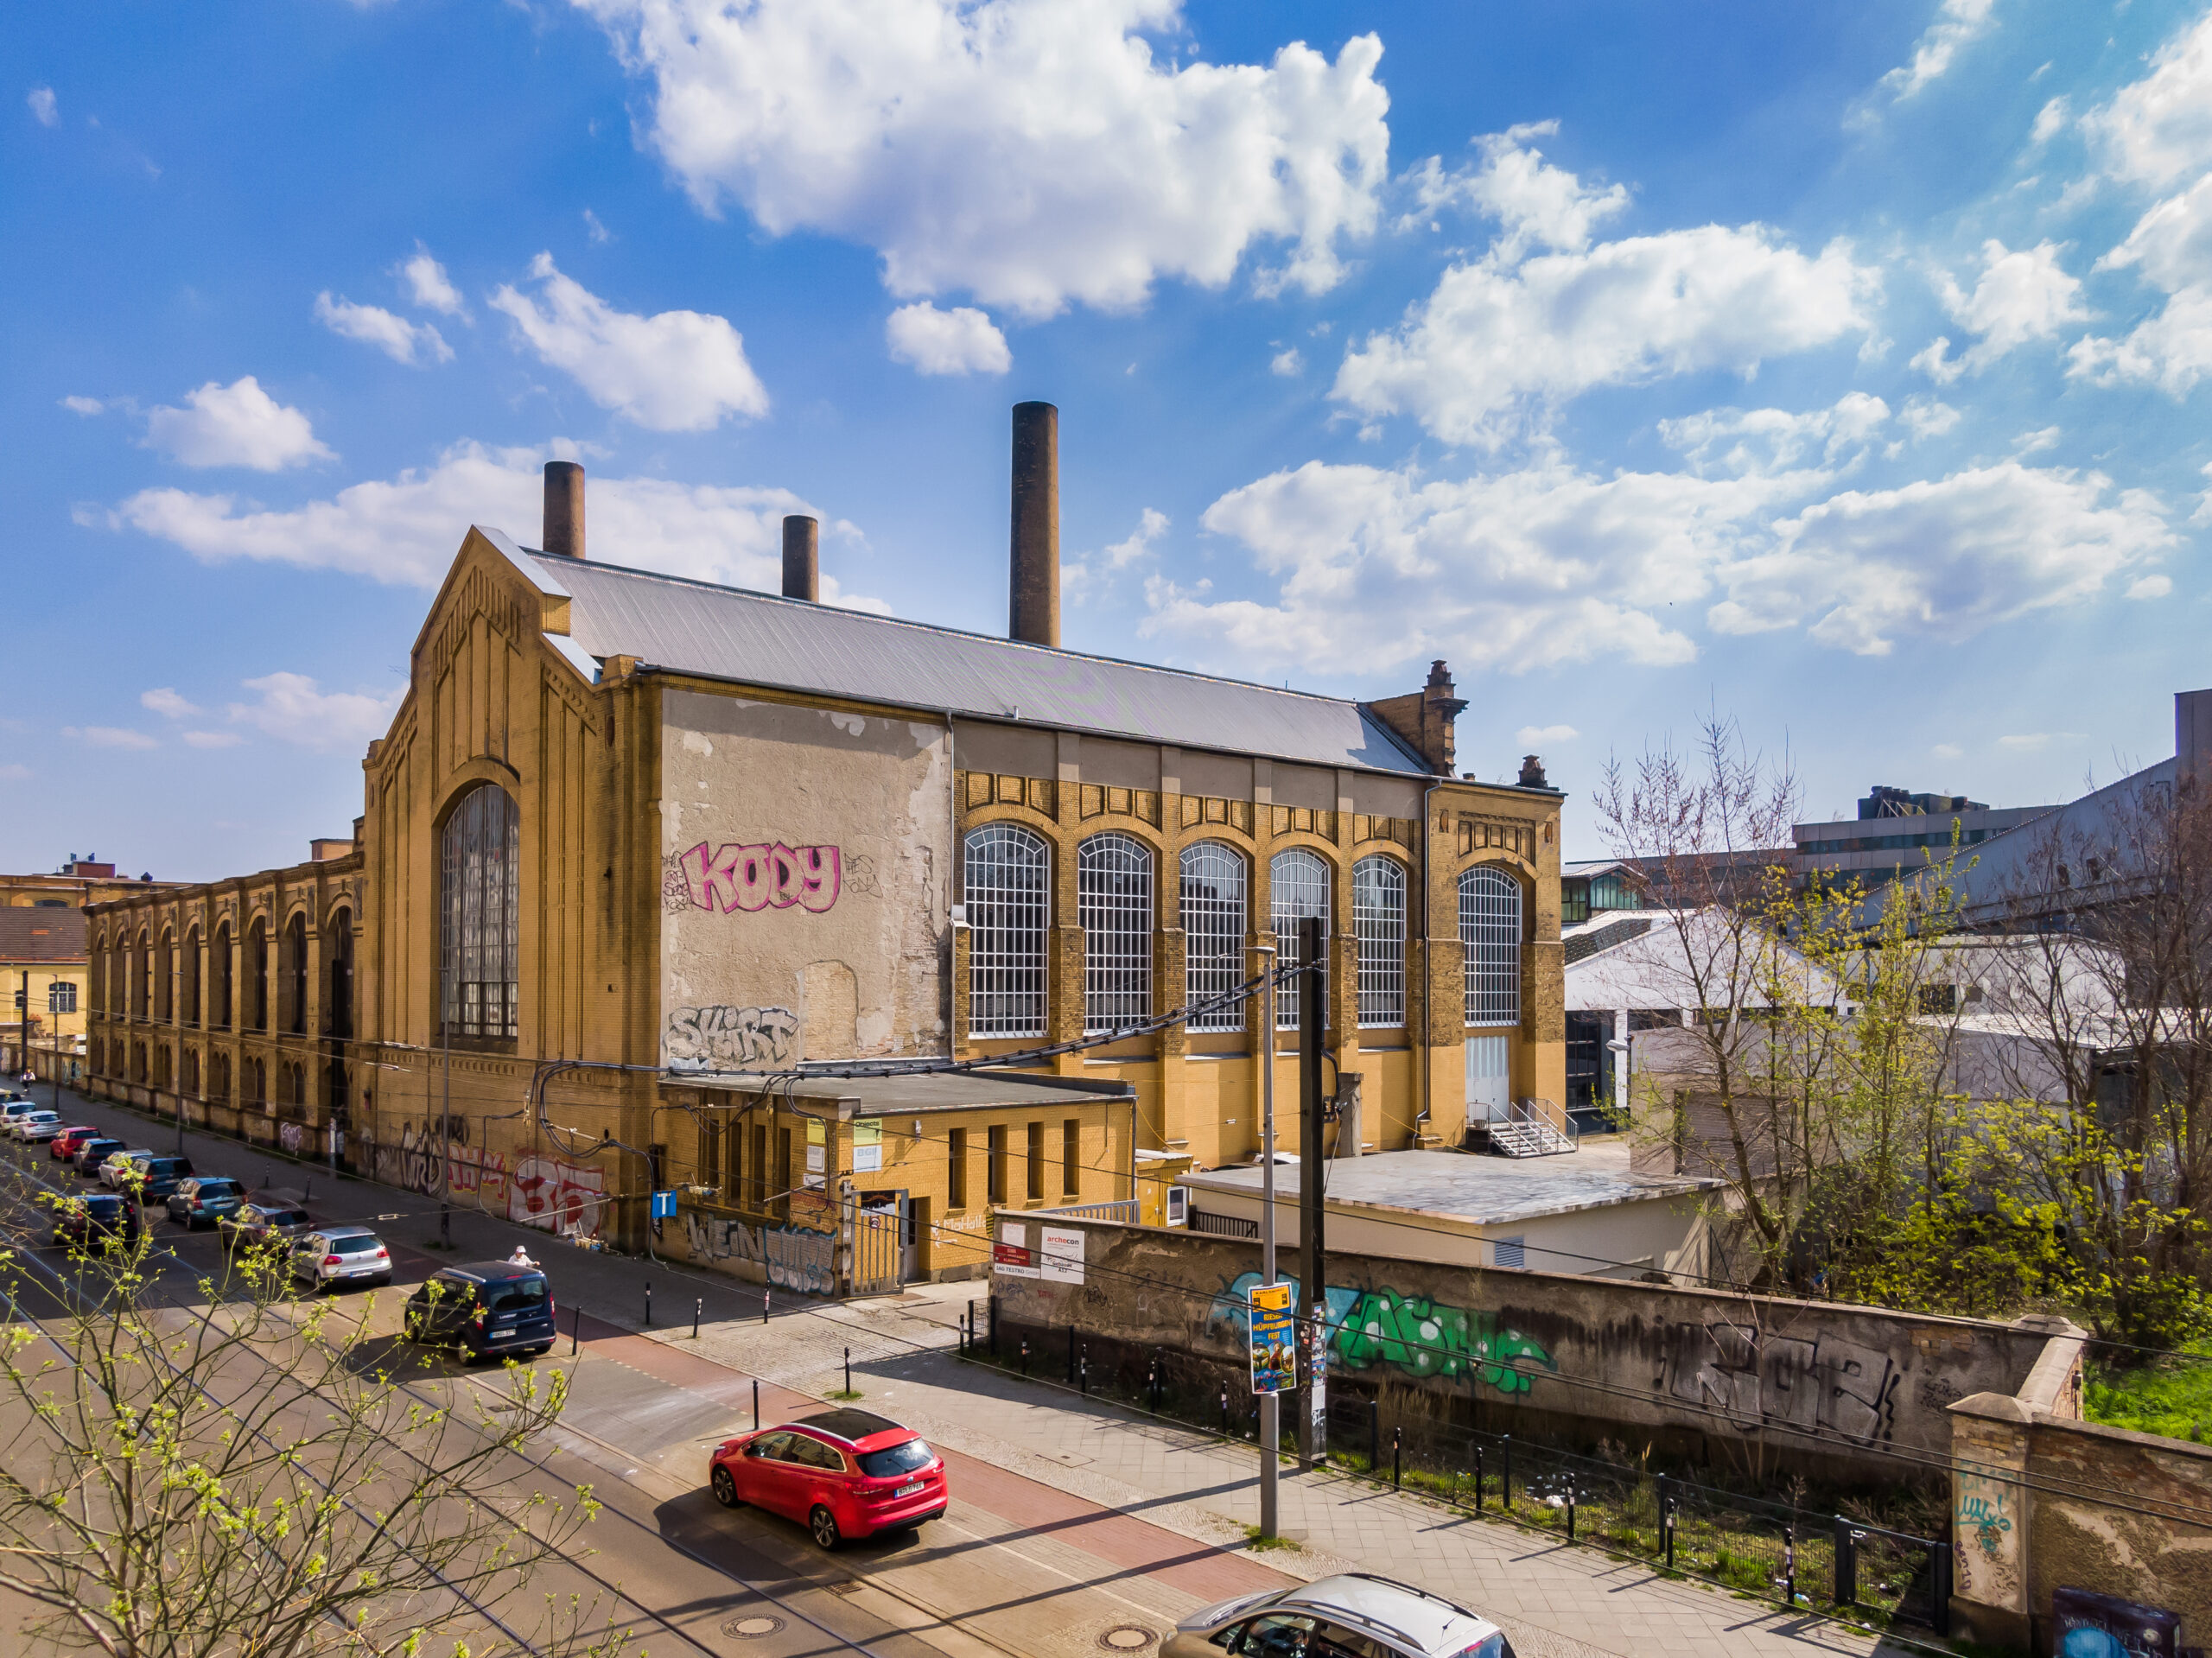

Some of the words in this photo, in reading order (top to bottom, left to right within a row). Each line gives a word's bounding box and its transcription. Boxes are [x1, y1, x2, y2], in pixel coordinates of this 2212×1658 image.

[680, 841, 839, 914] KODY
[657, 1193, 671, 1215] T
[1046, 1236, 1079, 1245] archecon
[1268, 1331, 1281, 1340] FEST
